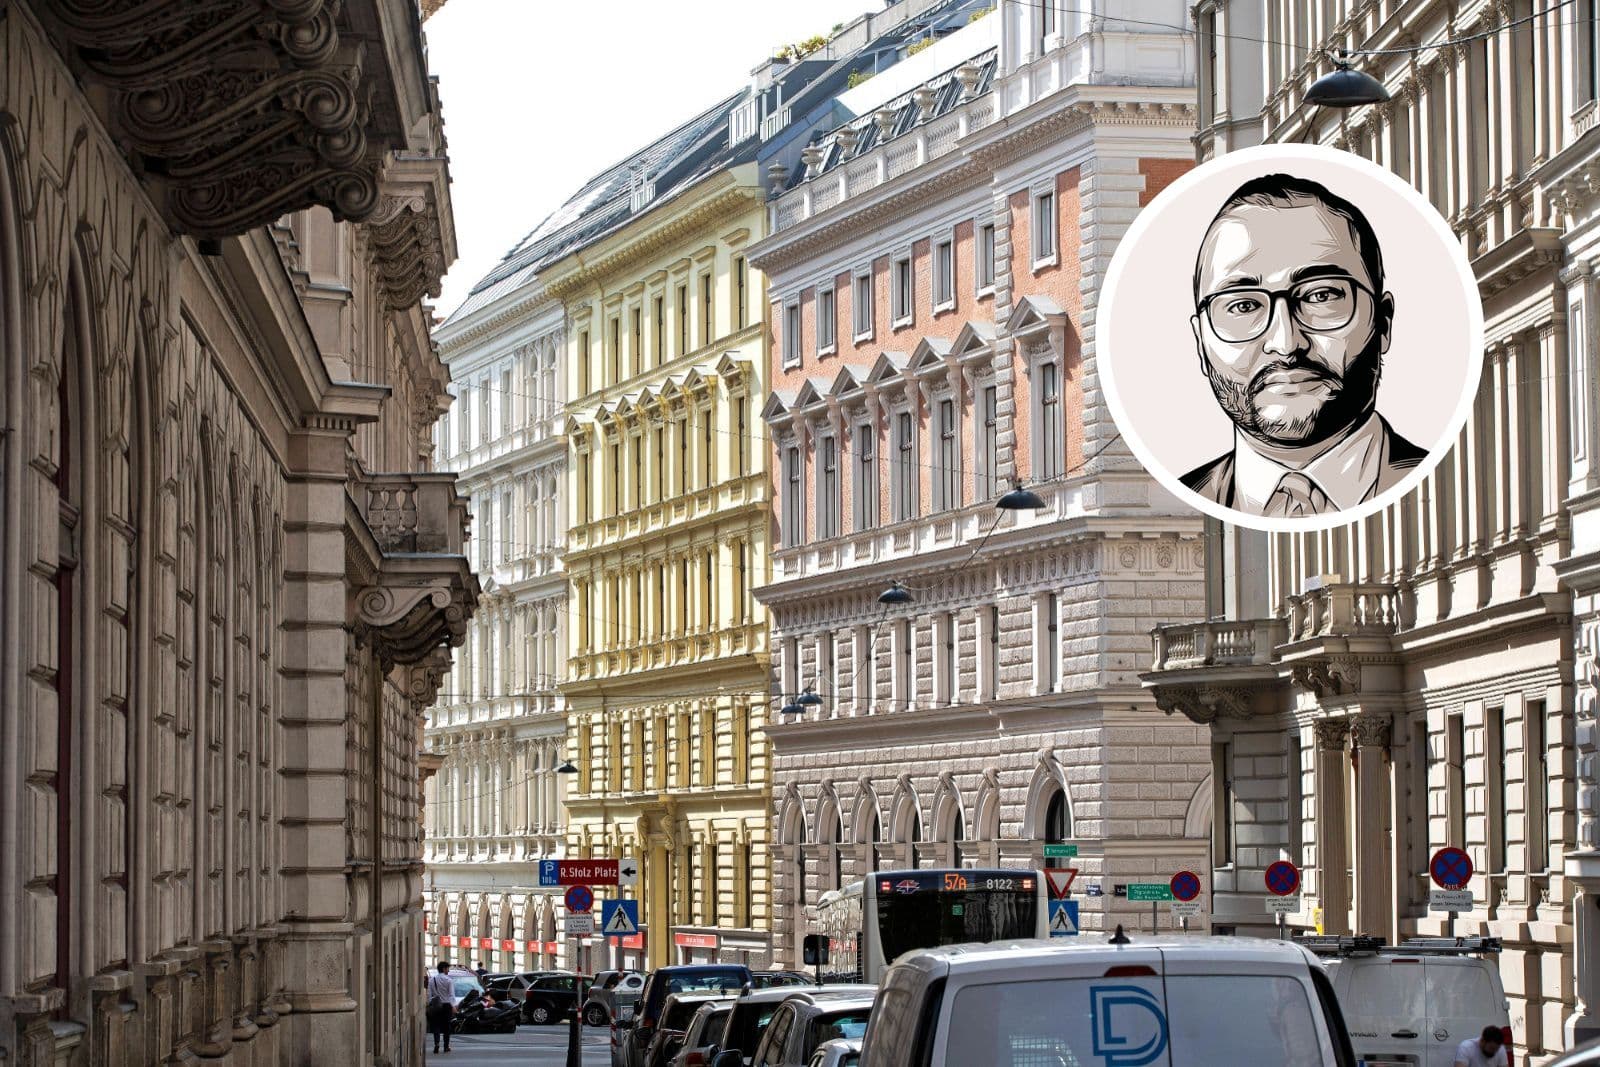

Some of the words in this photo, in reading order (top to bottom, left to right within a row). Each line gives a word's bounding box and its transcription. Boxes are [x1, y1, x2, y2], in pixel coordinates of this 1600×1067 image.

[594, 866, 617, 878] Platz
[944, 873, 967, 891] 57A
[986, 878, 1013, 890] 8122
